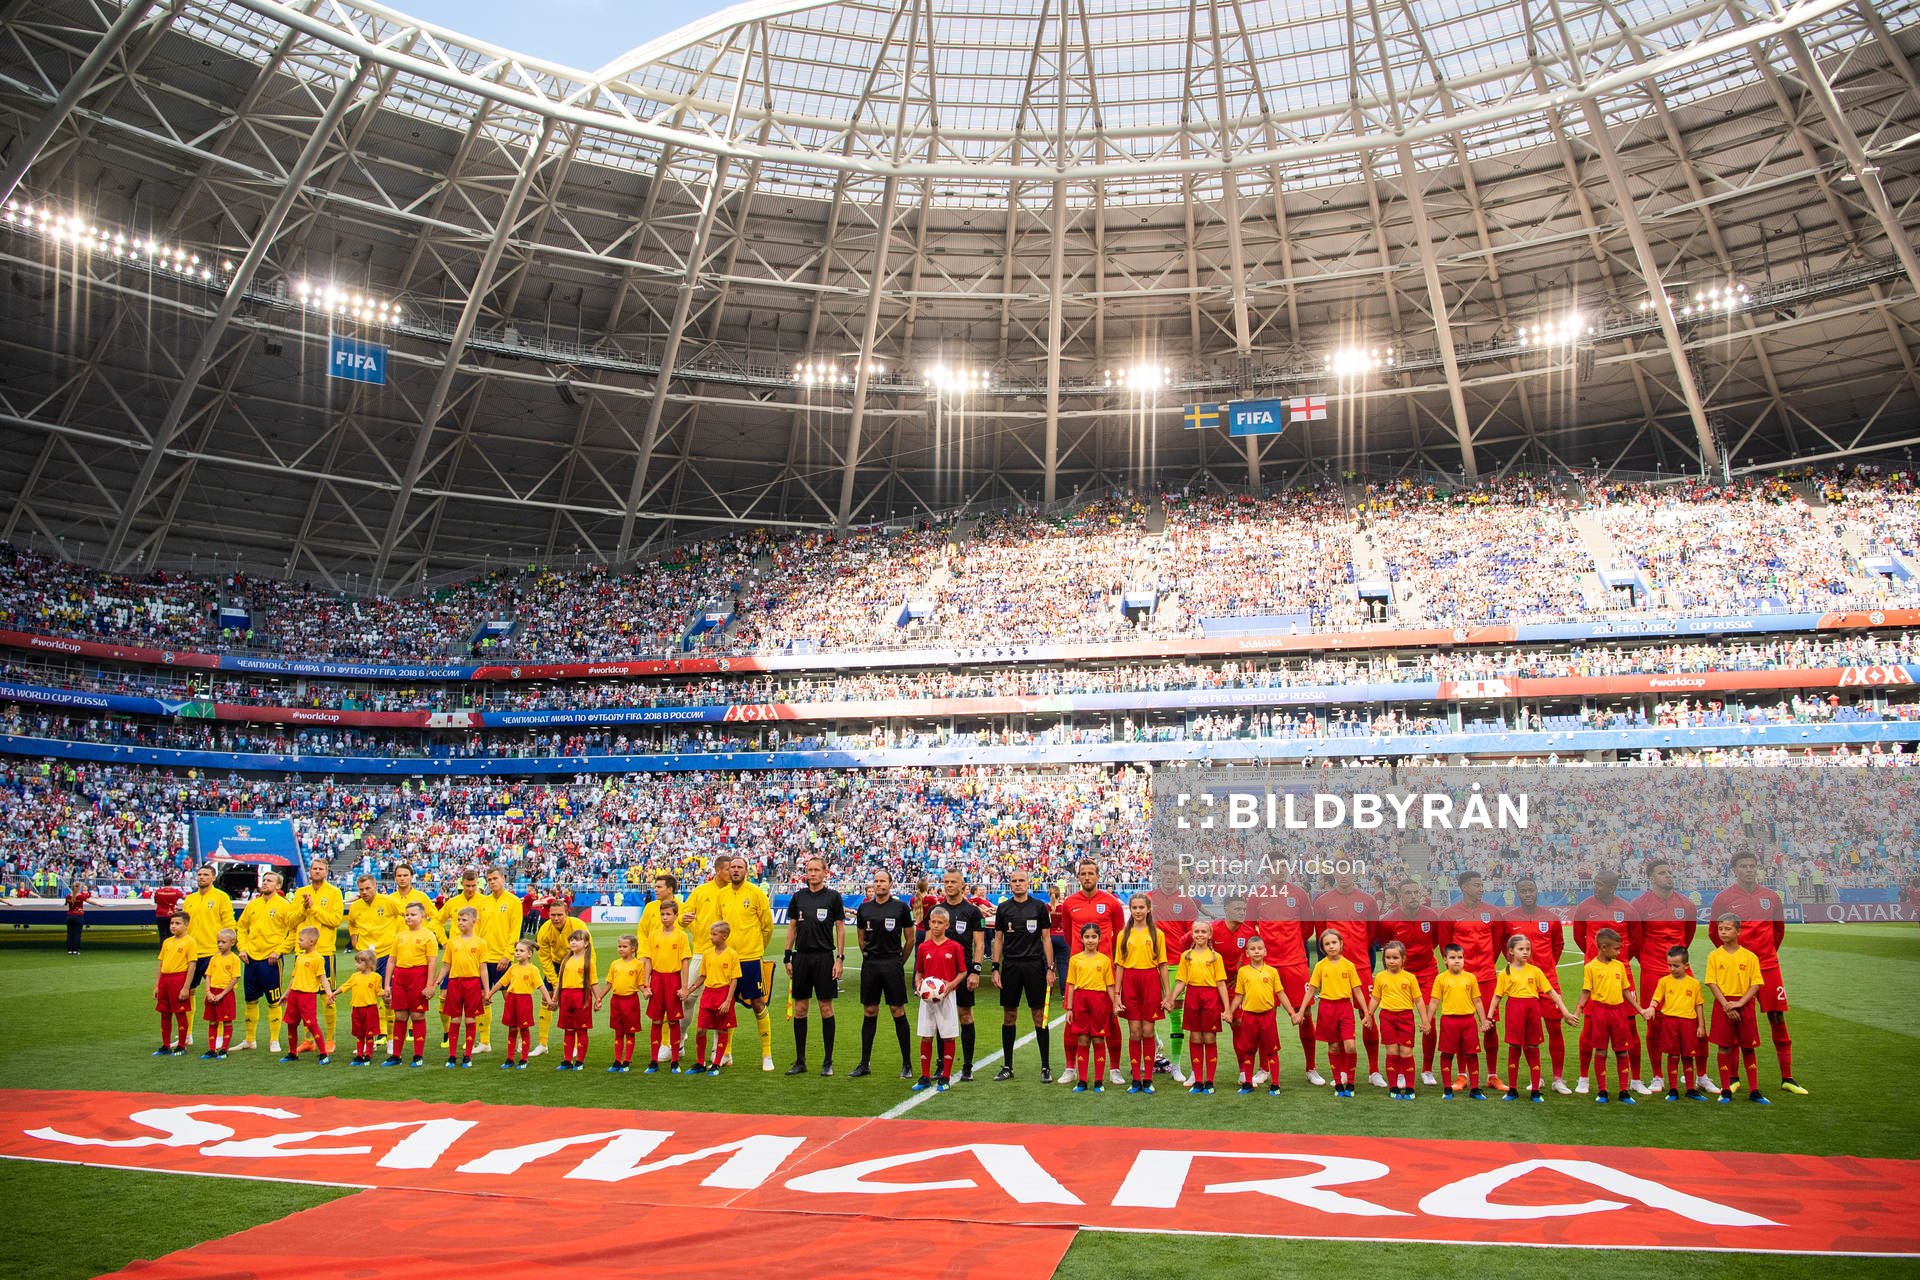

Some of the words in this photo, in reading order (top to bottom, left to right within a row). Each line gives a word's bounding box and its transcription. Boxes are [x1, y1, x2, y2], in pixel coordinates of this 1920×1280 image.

[336, 351, 377, 371] FIFA
[1236, 411, 1274, 425] FIFA
[1616, 624, 1639, 634] FIFA
[1689, 621, 1712, 631] CUP
[1713, 620, 1754, 631] RUSSIA
[31, 637, 81, 653] #worldcup
[1239, 640, 1283, 649] SAMARA
[237, 660, 292, 671] ЧЕМПИОНАТ
[294, 664, 320, 673] МИРА
[323, 665, 336, 673] ПО
[337, 666, 378, 677] ФУТБОЛУ
[379, 668, 397, 676] FIFA
[398, 669, 418, 677] 2018
[418, 669, 425, 677] В
[588, 666, 629, 675] #worldcup
[1650, 676, 1705, 688] #worldcup
[16, 689, 50, 701] WORLD
[51, 692, 72, 703] CUP
[73, 695, 108, 707] RUSSIA
[1187, 694, 1210, 704] 2018
[1210, 694, 1231, 704] FIFA
[1231, 693, 1267, 703] WORLD
[1268, 692, 1289, 702] CUP
[1290, 691, 1327, 701] RUSSIA
[292, 711, 339, 722] #worldcup
[502, 715, 550, 724] ЧЕМПИОНАТ
[551, 714, 573, 722] МИРА
[575, 714, 586, 722] ПО
[588, 713, 624, 722] ФУТБОЛУ
[625, 712, 642, 720] FIFA
[643, 712, 662, 720] 2018
[663, 711, 669, 719] В
[670, 711, 704, 719] РОССИИ
[1826, 903, 1904, 922] QATAR
[268, 987, 281, 1001] 10
[23, 1104, 1785, 1227] SAMARA
